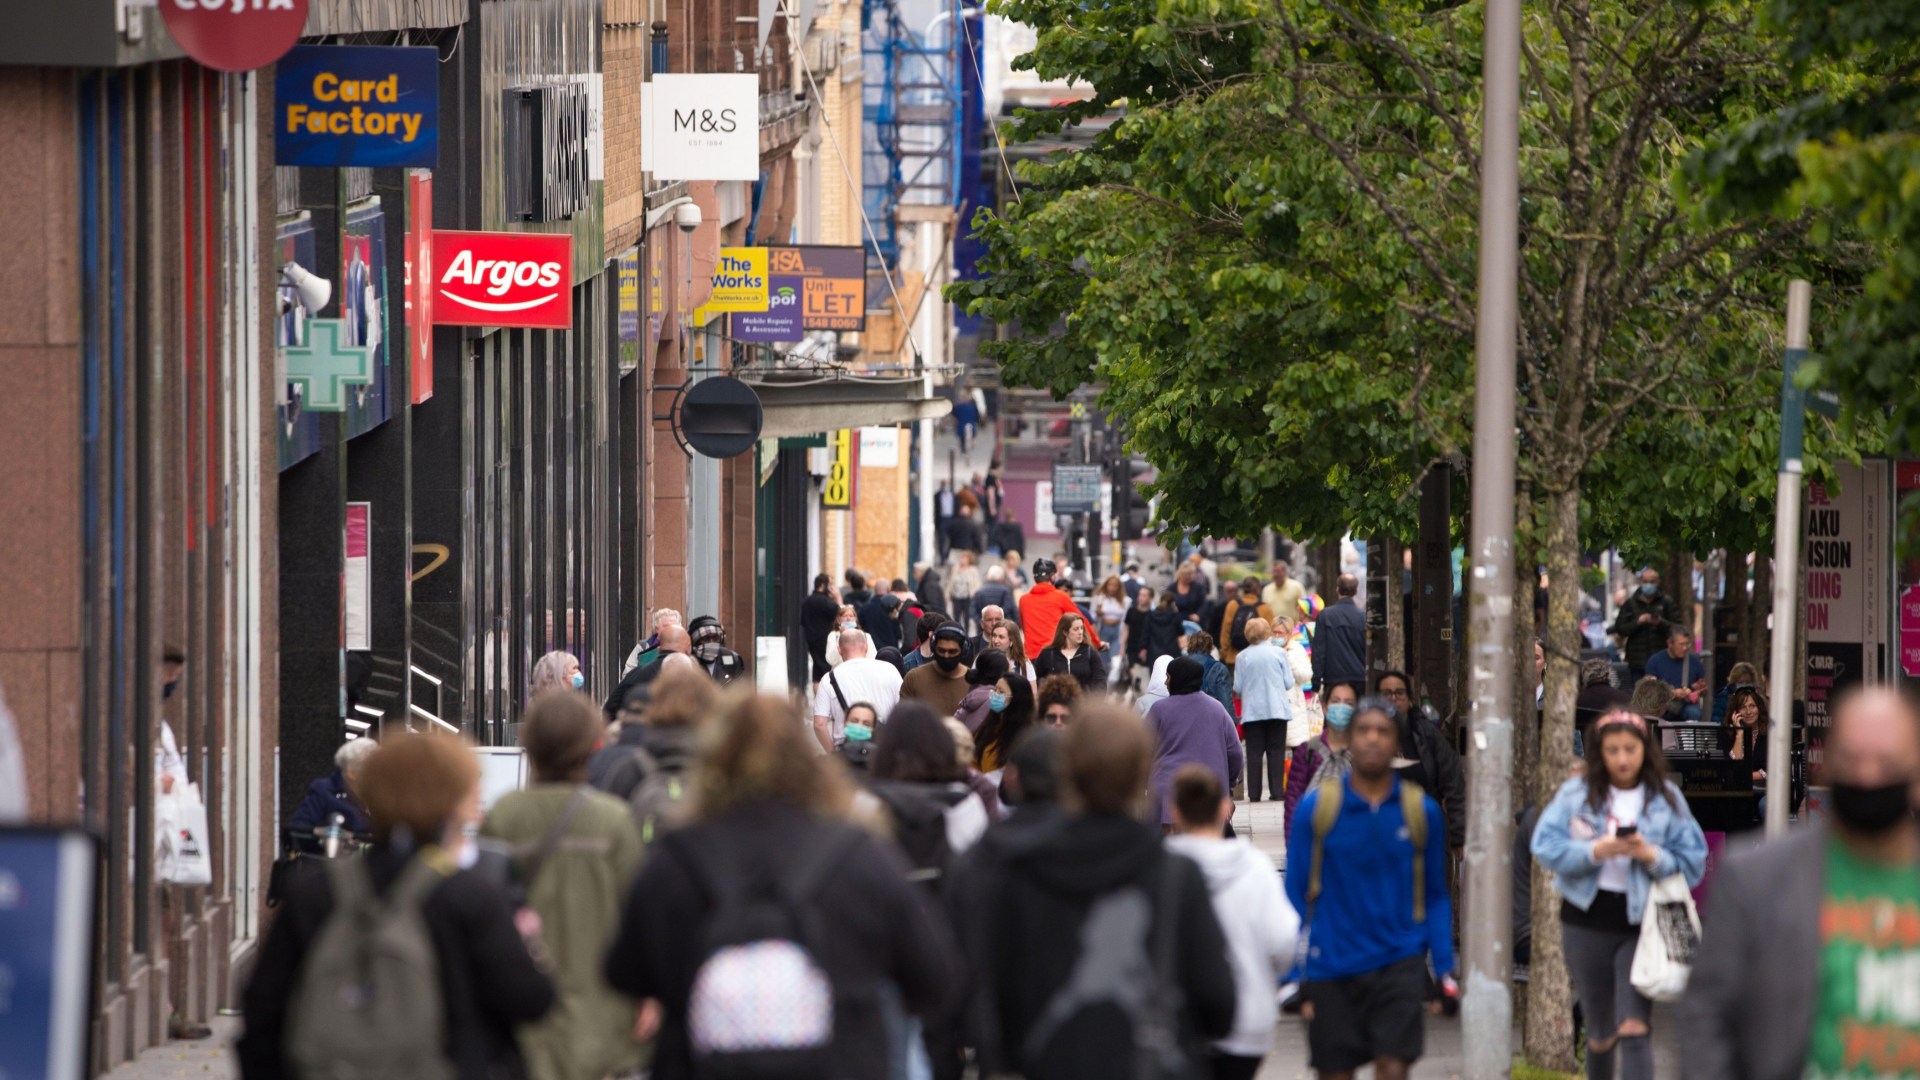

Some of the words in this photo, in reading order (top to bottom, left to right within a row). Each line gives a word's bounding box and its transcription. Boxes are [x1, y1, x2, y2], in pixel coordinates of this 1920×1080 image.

[313, 72, 399, 103] Card
[287, 104, 423, 142] Factory
[674, 108, 737, 133] M&S
[441, 249, 562, 296] Argos
[721, 257, 751, 271] The
[712, 274, 762, 288] Works
[805, 280, 833, 291] Unit
[808, 294, 856, 314] LET
[743, 317, 766, 325] Mobile
[767, 317, 793, 326] Repairs
[1808, 509, 1840, 537] AKU
[1808, 571, 1841, 600] NING
[1808, 602, 1829, 631] ON
